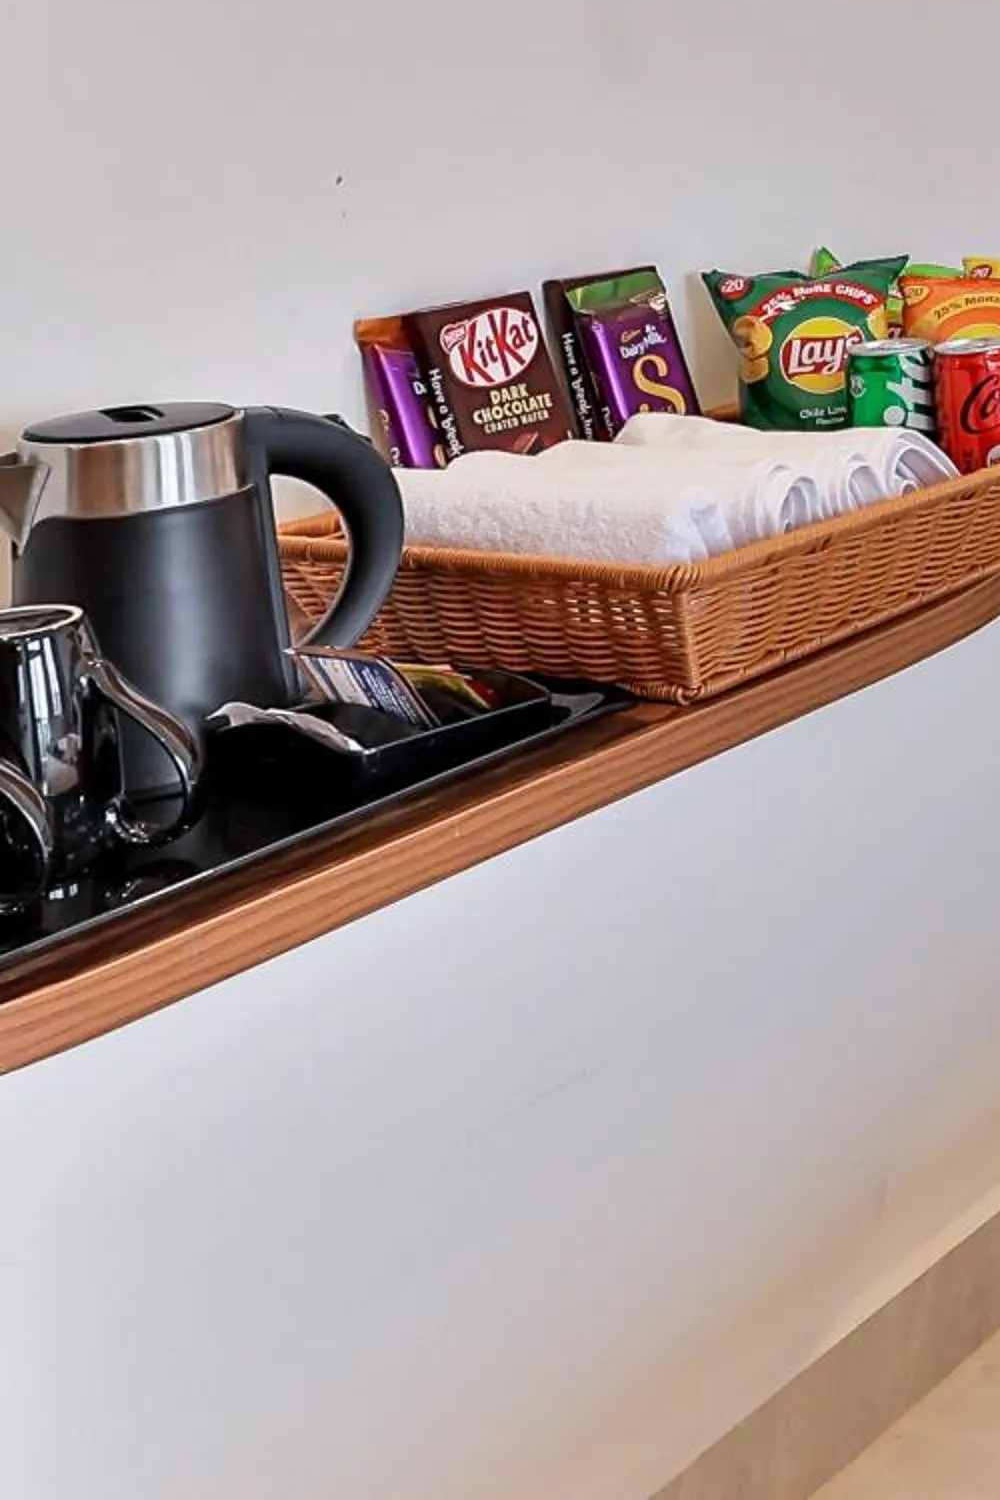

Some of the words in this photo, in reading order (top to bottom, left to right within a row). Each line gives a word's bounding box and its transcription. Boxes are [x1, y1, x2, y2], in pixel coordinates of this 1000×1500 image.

[457, 309, 535, 384] KitKat
[473, 393, 553, 424] CHOCOLATE
[489, 383, 529, 405] DARK
